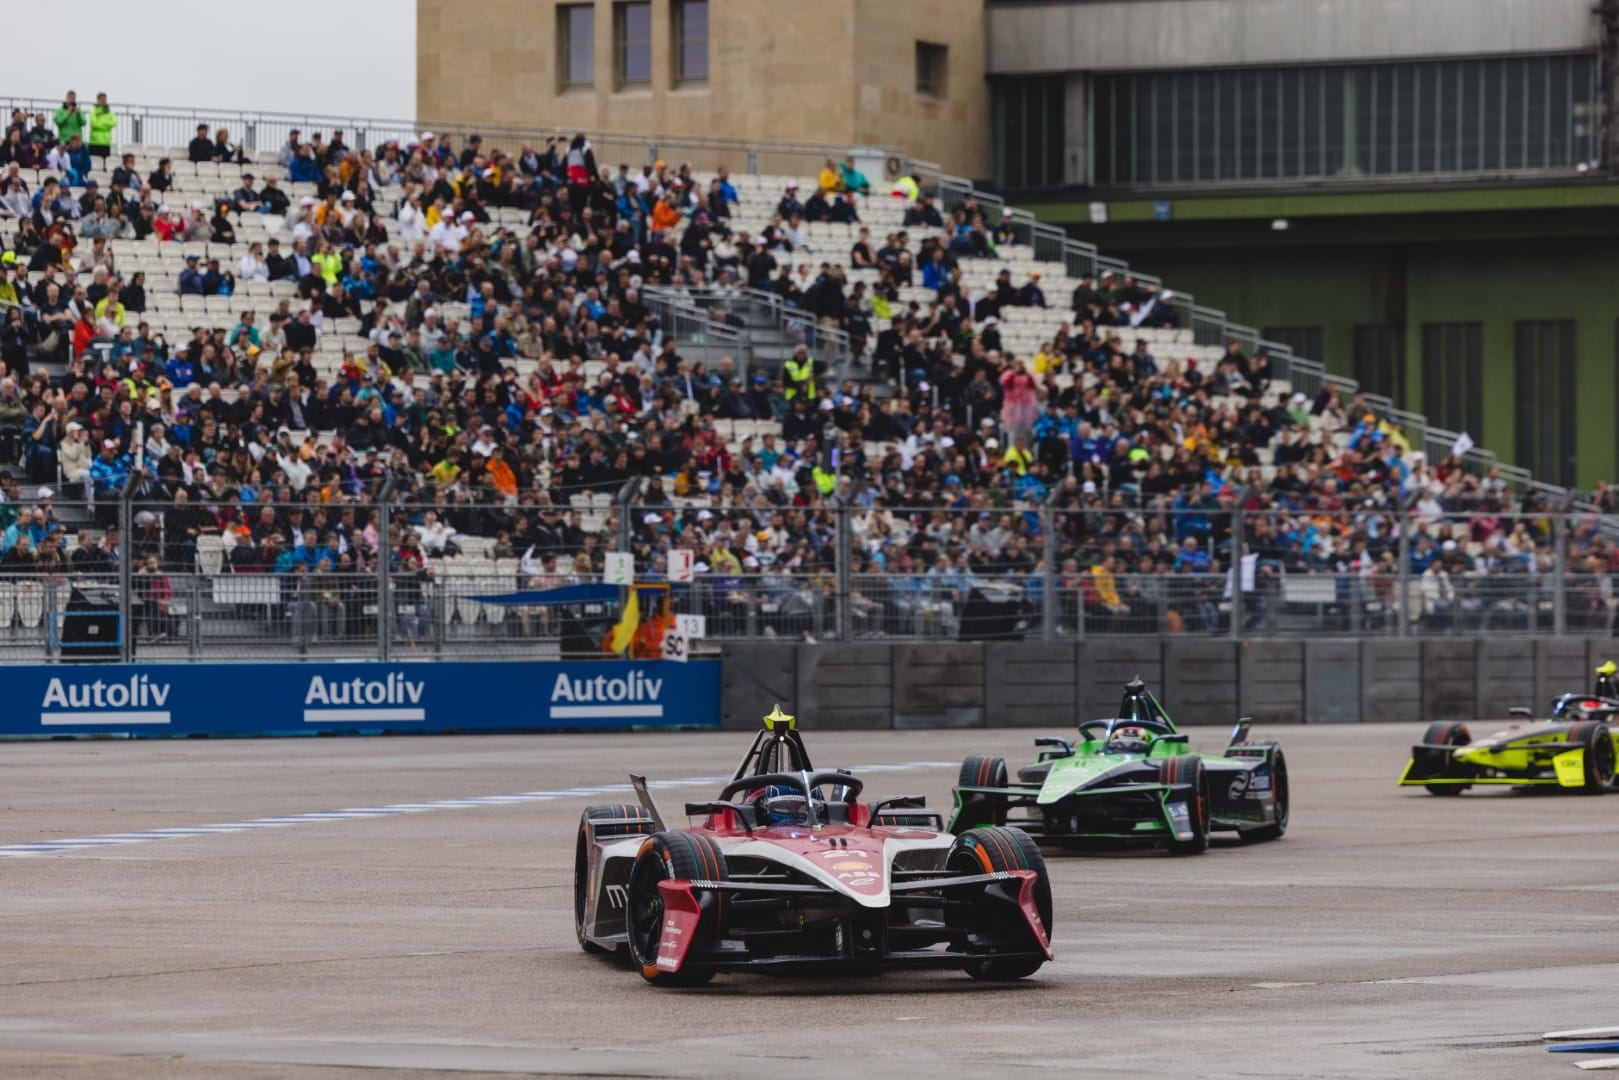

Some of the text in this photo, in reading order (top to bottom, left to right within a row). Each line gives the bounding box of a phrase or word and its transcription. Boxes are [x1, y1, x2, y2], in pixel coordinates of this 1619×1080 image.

[683, 618, 699, 634] 13
[666, 634, 684, 656] SC
[42, 673, 171, 708] Autoliv
[304, 671, 425, 705] Autoliv
[550, 669, 663, 702] Autoliv
[821, 849, 868, 858] 21
